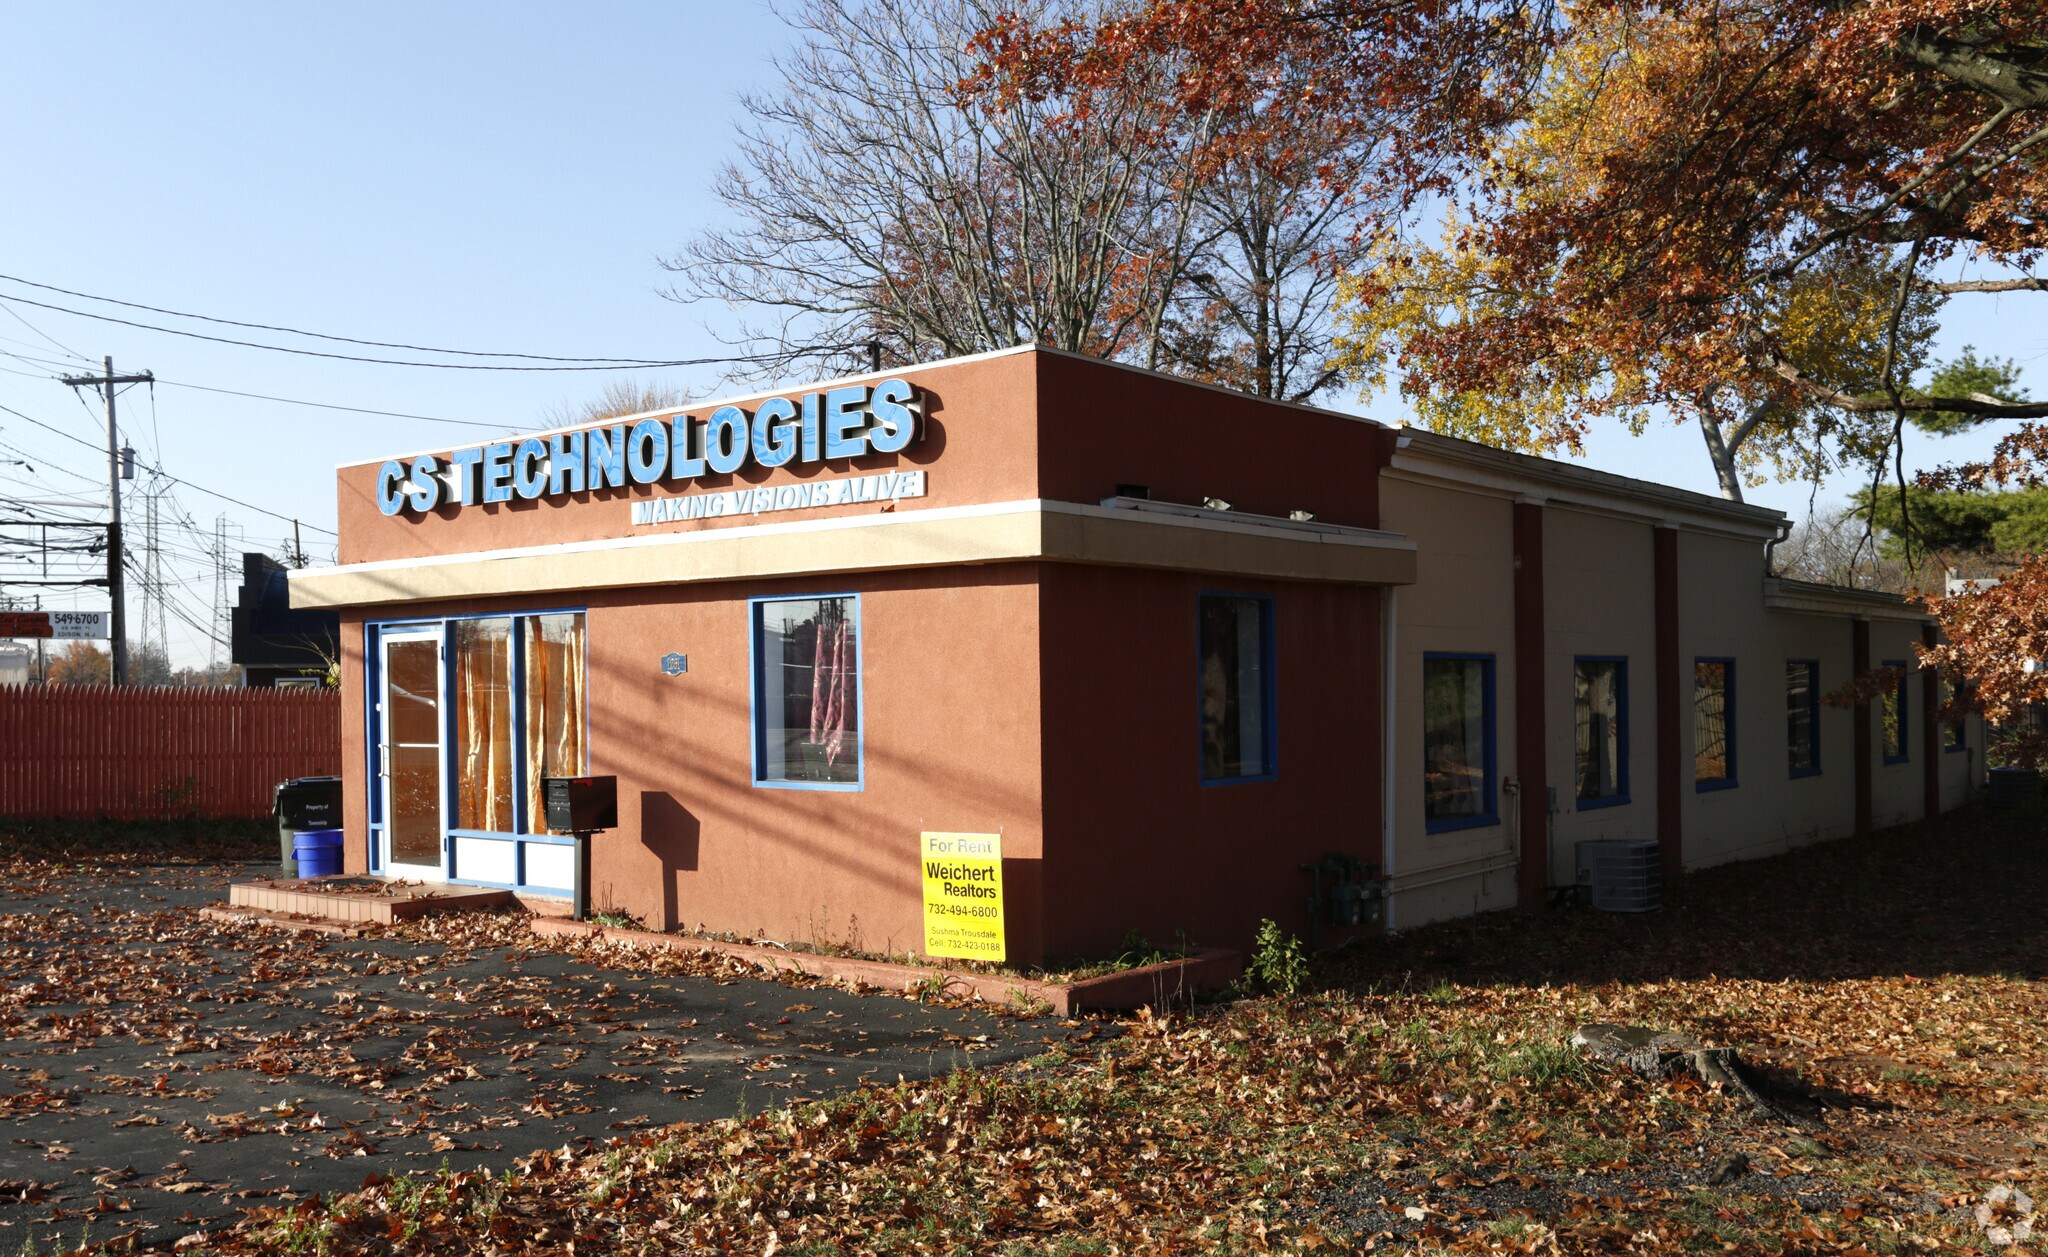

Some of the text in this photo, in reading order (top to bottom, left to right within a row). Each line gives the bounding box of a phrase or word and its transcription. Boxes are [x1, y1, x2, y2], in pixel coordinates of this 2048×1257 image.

[452, 378, 916, 504] TECHNOLOGIES
[638, 471, 917, 524] MAKING VISIONS ALIVE
[54, 613, 99, 625] 549-6700
[929, 838, 992, 854] For Rent
[944, 882, 997, 899] Realtors
[928, 903, 997, 918] 732-494-6800
[931, 927, 960, 936] Sushma
[947, 940, 1001, 952] 732-423-0188
